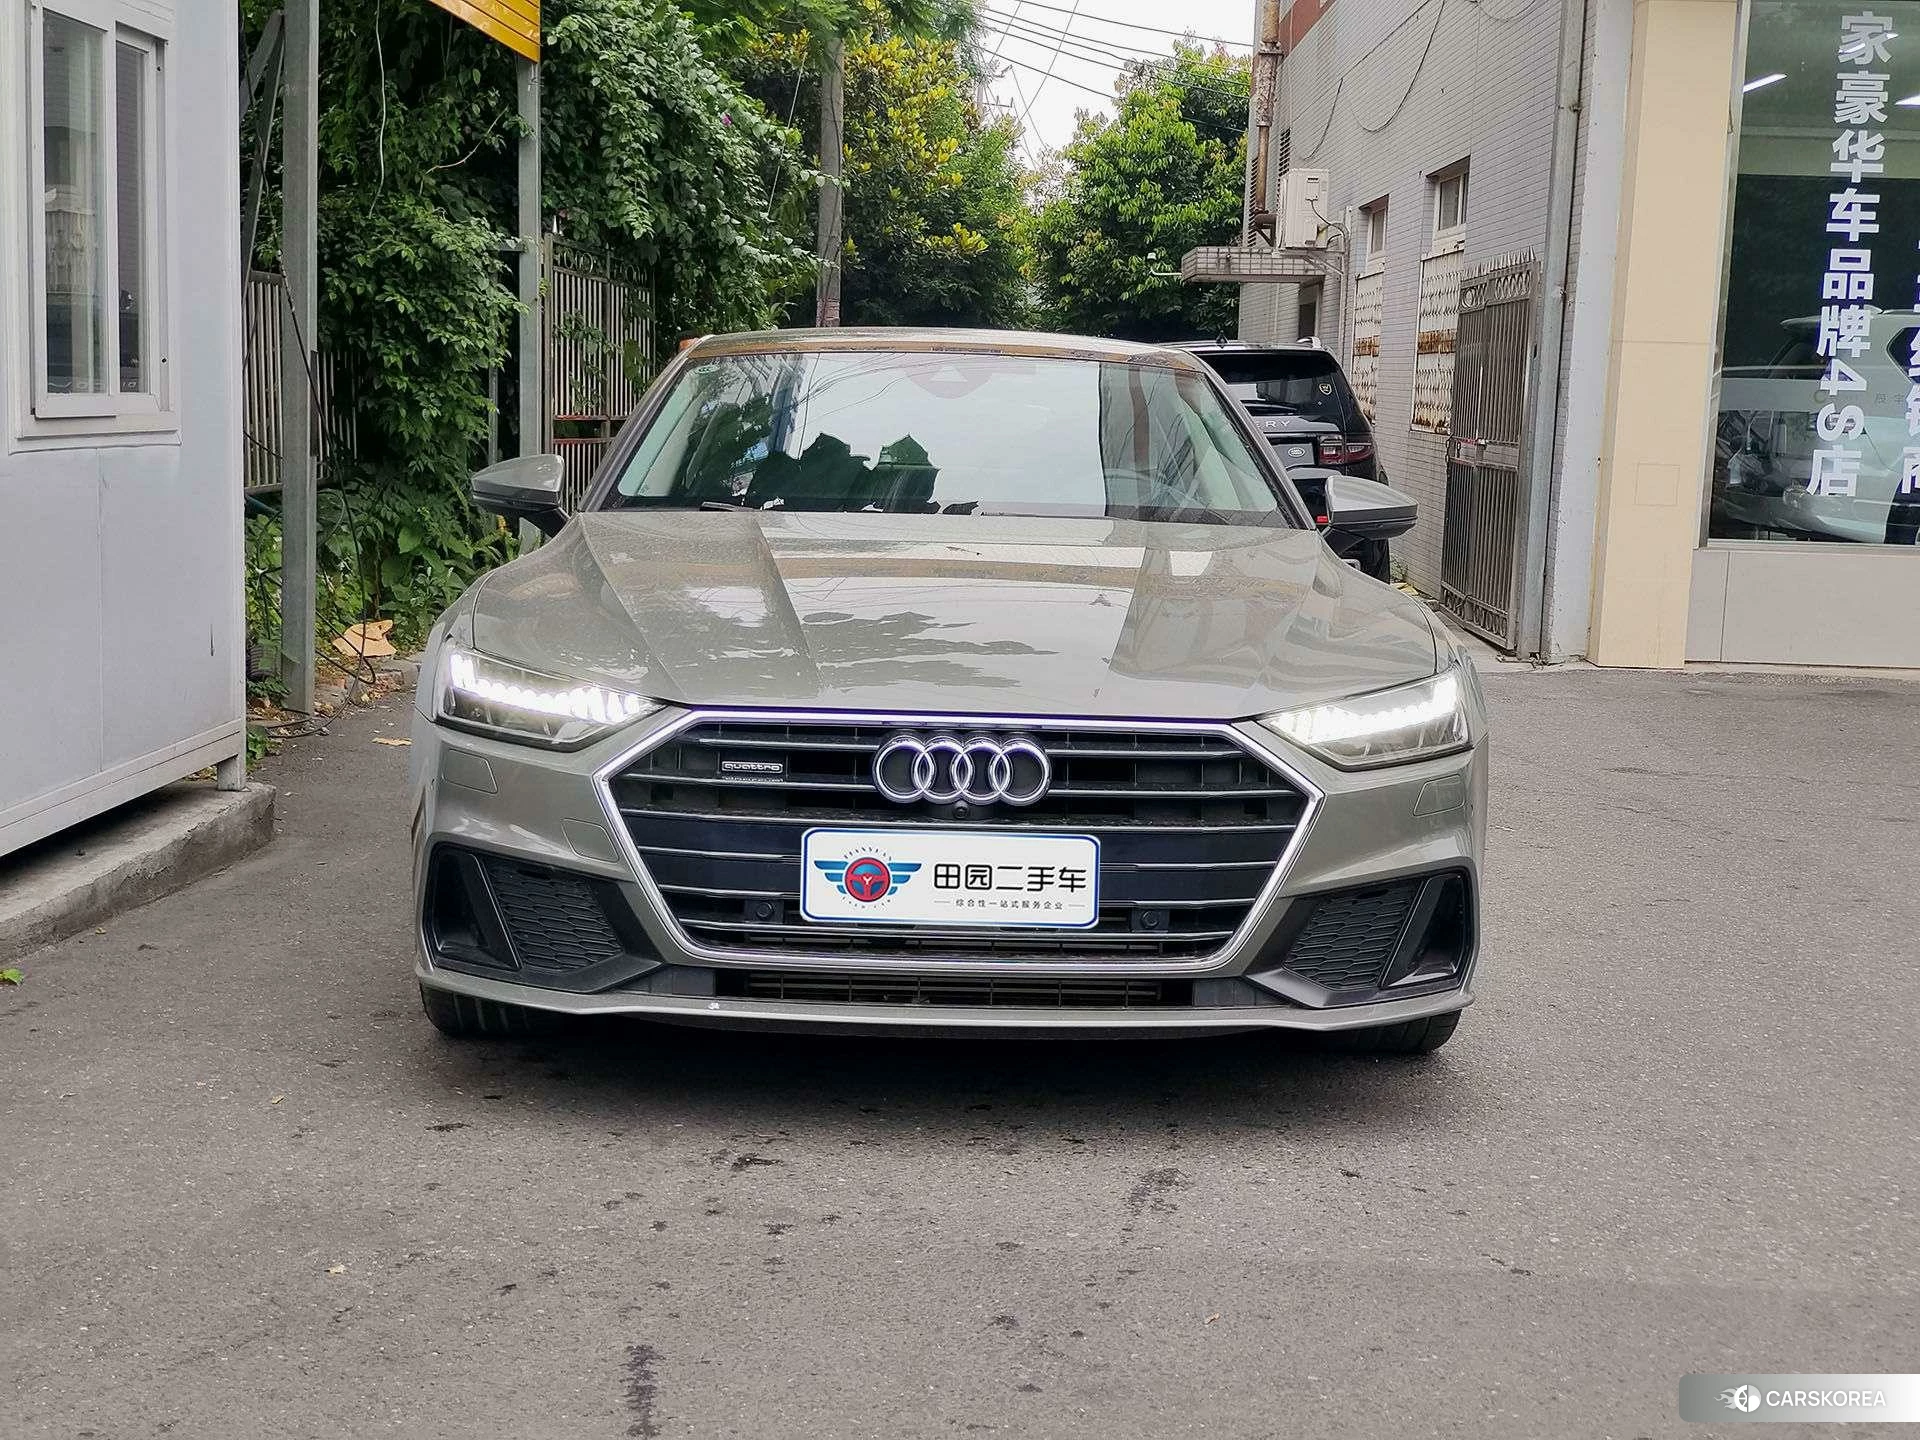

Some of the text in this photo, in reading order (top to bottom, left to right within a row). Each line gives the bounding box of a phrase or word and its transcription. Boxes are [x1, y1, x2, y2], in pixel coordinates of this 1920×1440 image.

[1806, 11, 1893, 498] 家豪华车品牌4S店
[724, 762, 781, 772] quattro
[934, 863, 1087, 893] 田园二手车
